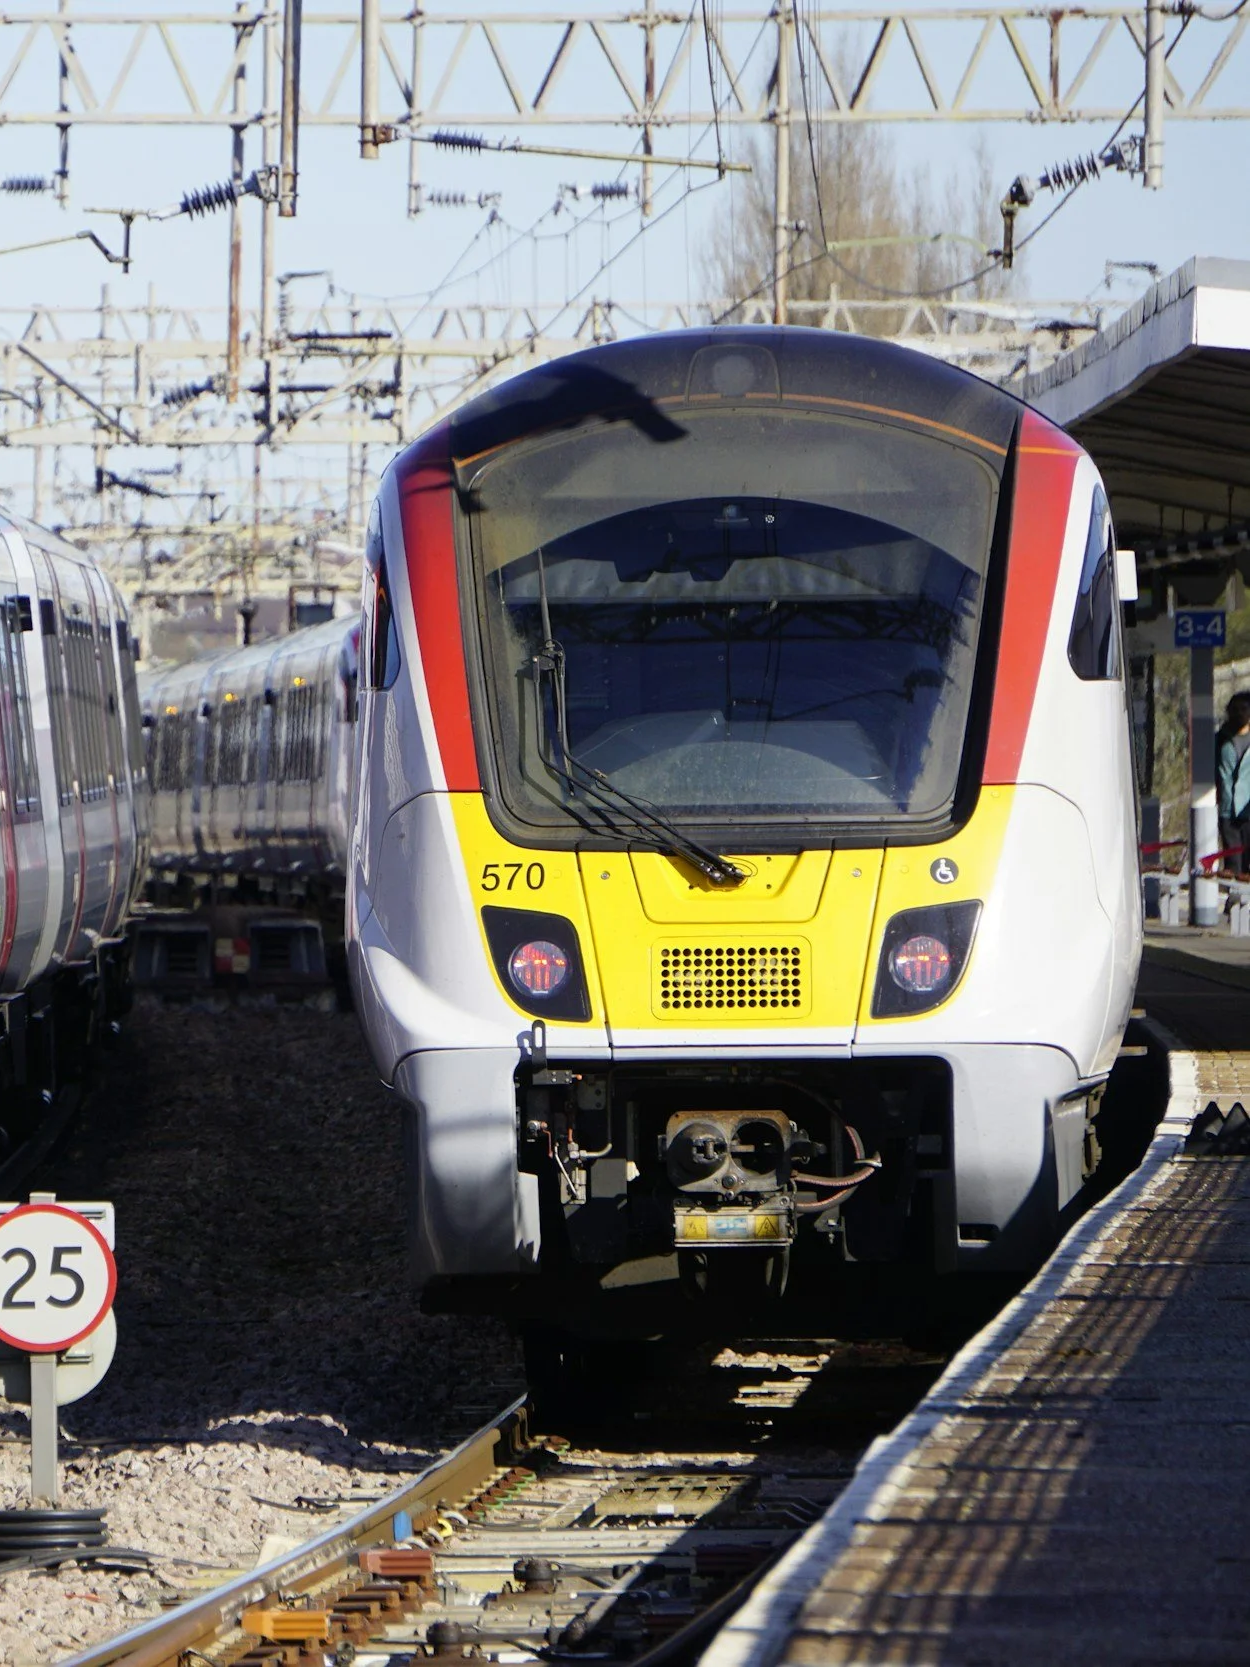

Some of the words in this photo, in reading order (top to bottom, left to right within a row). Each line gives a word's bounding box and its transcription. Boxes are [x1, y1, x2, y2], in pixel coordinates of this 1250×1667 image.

[1178, 615, 1223, 637] 3-4
[481, 862, 545, 891] 570
[1, 1246, 85, 1309] 25
